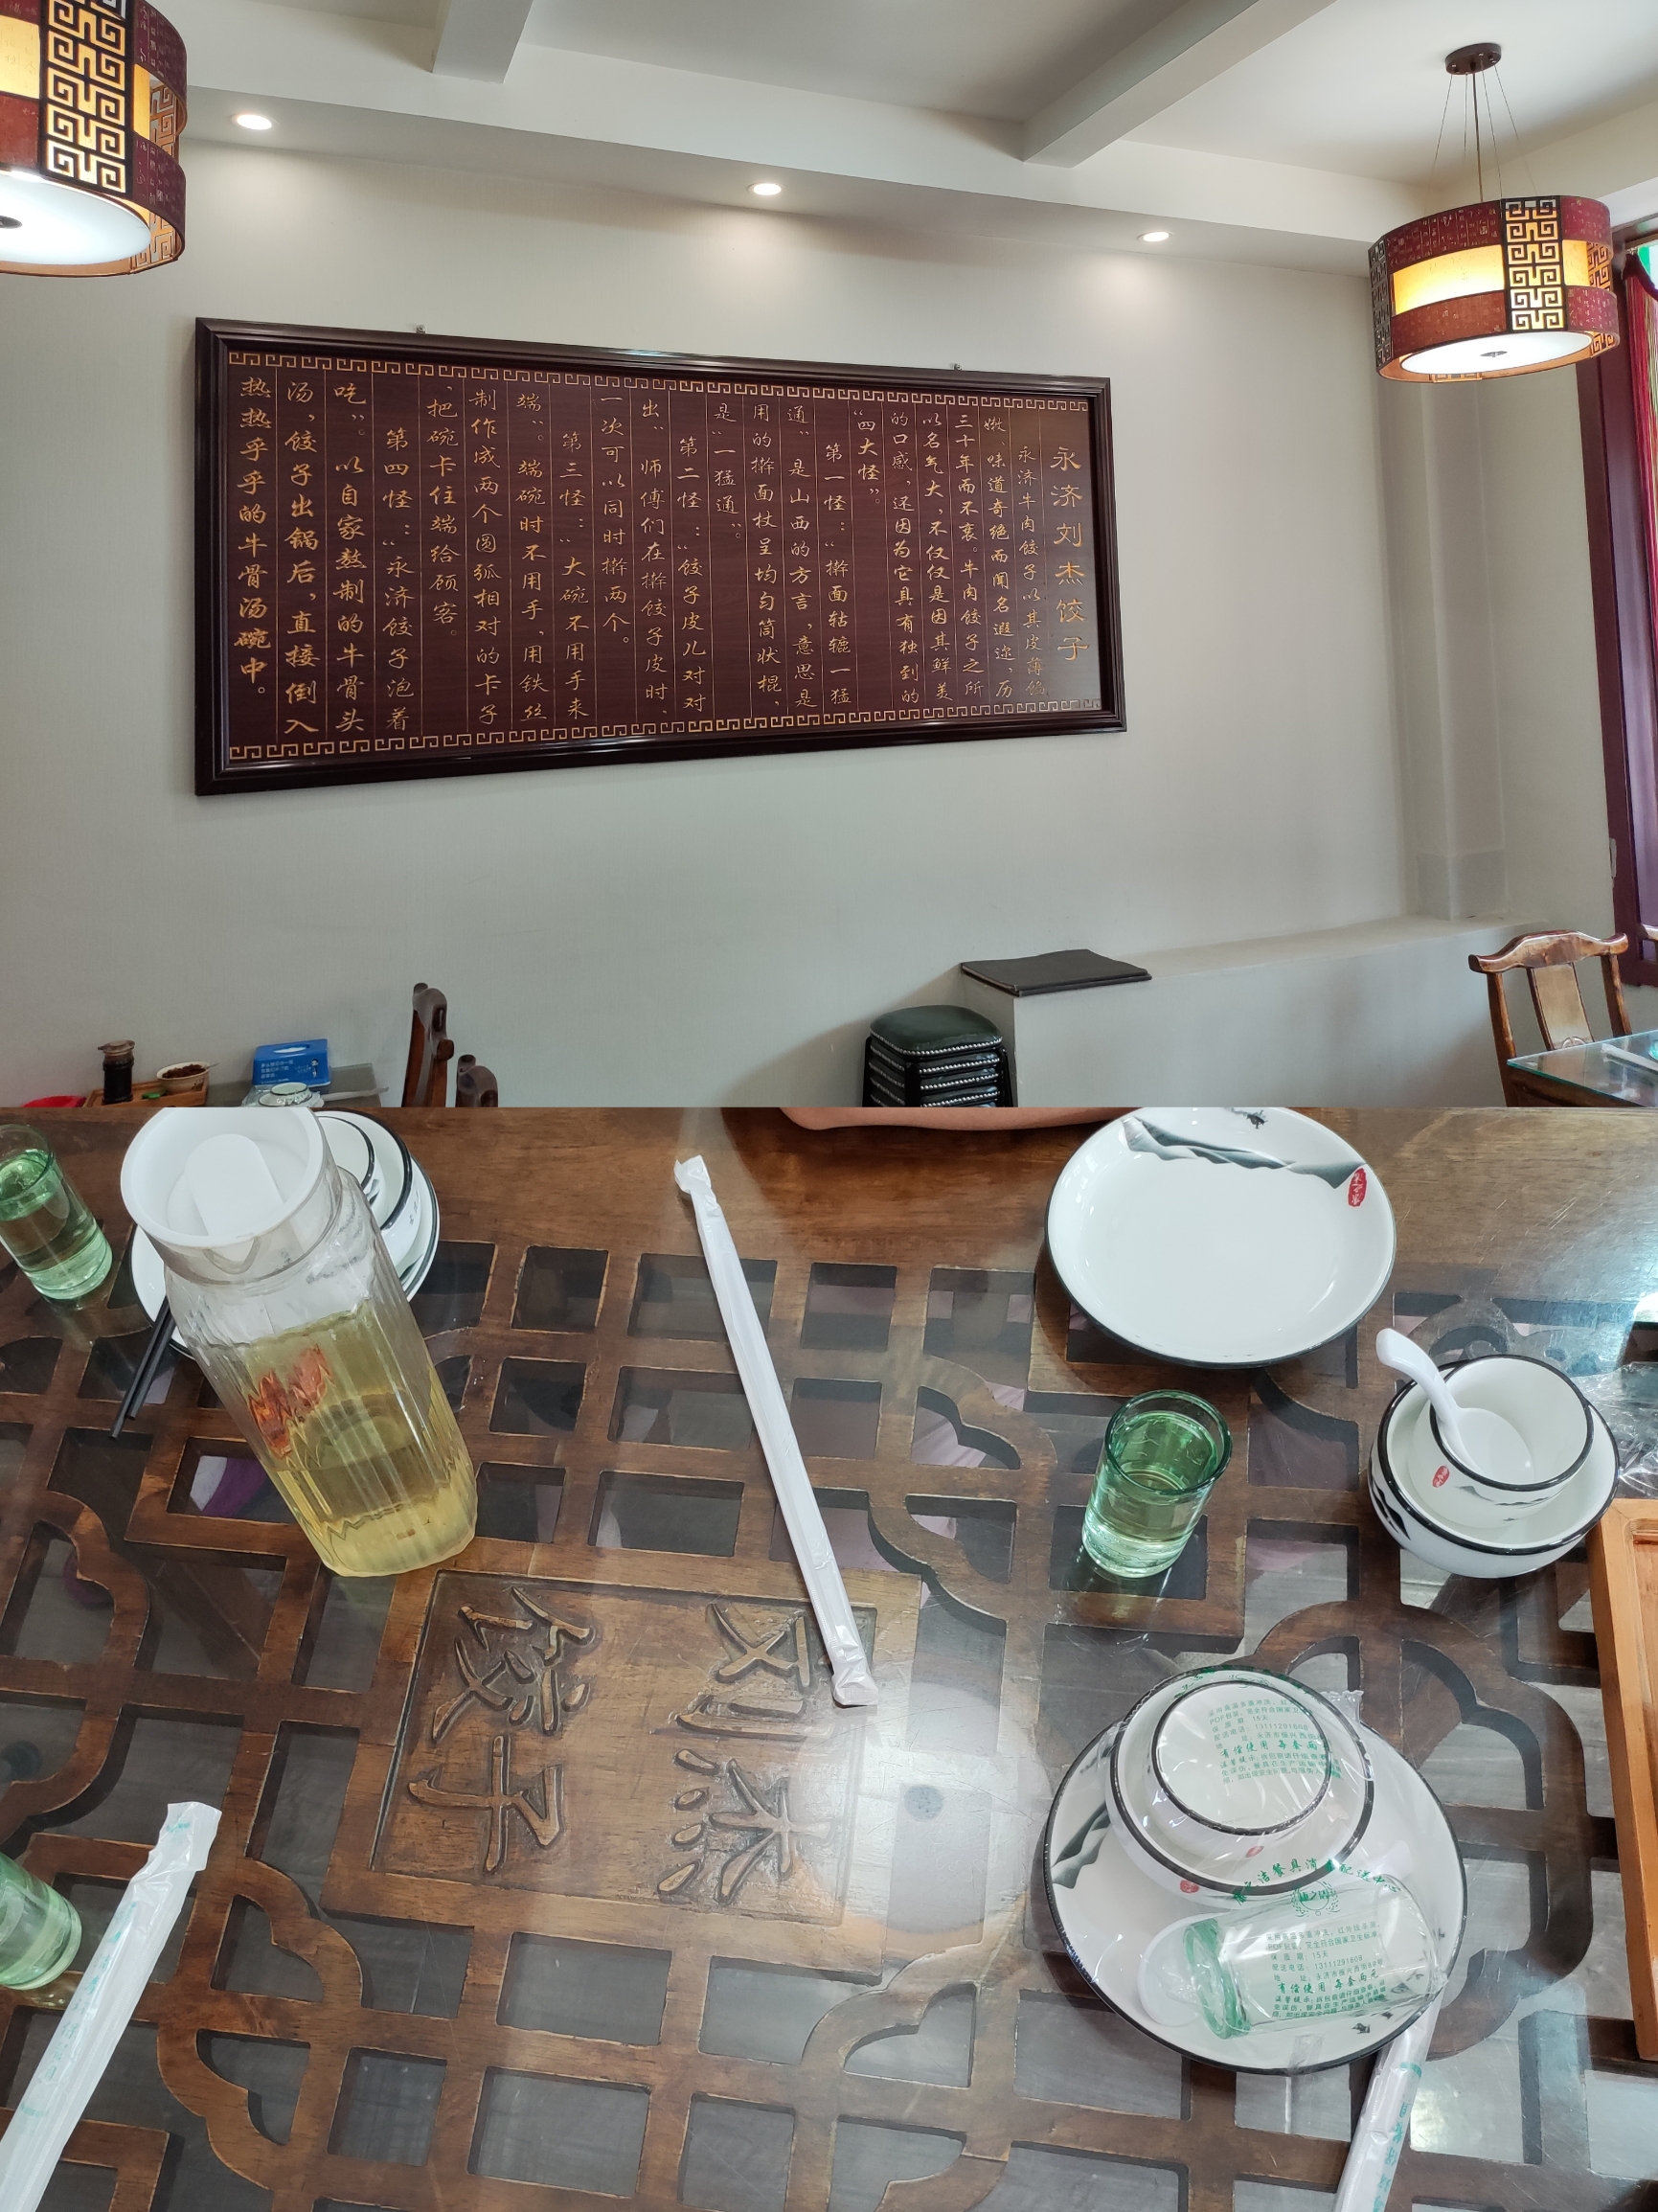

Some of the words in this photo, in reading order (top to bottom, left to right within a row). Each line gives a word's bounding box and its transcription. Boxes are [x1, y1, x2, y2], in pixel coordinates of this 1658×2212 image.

[468, 389, 503, 725] 制作成两个圆弧相对的卡子
[1016, 445, 1046, 696] 永济牛肉饺子以其皮薄馅
[1049, 445, 1090, 662] 永济刘杰饺子
[408, 1585, 597, 1876] 饺子
